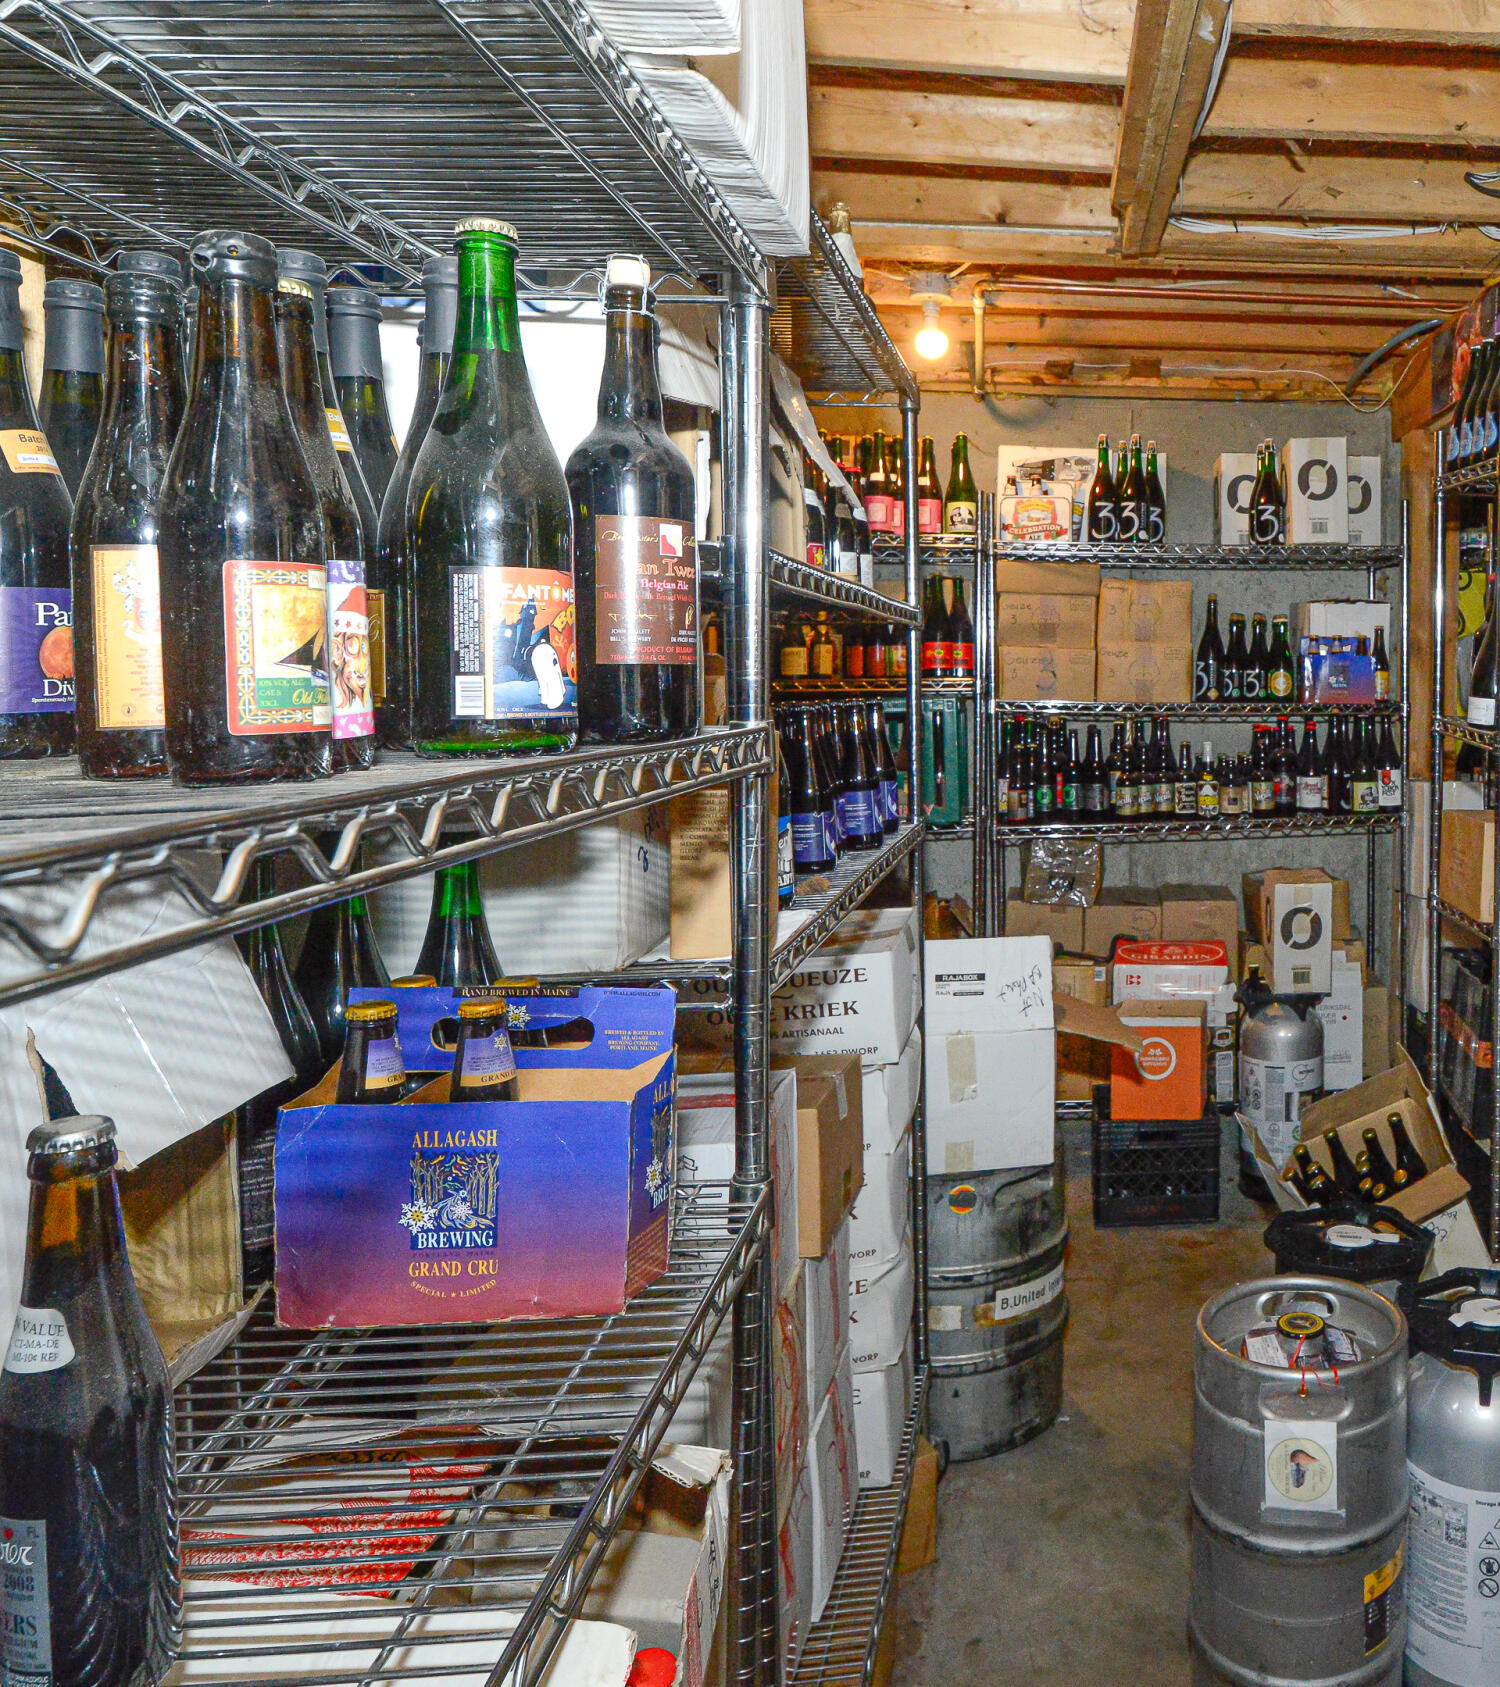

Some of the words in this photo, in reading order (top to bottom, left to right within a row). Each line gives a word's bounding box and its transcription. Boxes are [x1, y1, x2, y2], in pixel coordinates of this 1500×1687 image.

[1008, 523, 1061, 535] CELEBRATION
[1091, 501, 1116, 539] 3
[1119, 501, 1139, 540] 3
[1255, 505, 1279, 542] 3
[501, 580, 574, 603] FANTÔME
[640, 578, 676, 592] Belgian
[786, 967, 868, 988] UEUZE
[490, 988, 527, 997] BREWED
[529, 988, 540, 997] IN
[542, 988, 571, 997] MAINE
[783, 1000, 860, 1021] KRIEK
[781, 1026, 845, 1039] ARTISANAAL
[480, 1072, 510, 1084] GRAND
[412, 1129, 498, 1149] ALLAGASH
[417, 1230, 494, 1249] BREWING
[408, 1260, 462, 1278] GRAND
[467, 1259, 499, 1276] CRU
[410, 1281, 447, 1298] SPECIAL
[460, 1279, 497, 1297] LIMITED
[1000, 1286, 1046, 1311] B.United
[22, 1320, 65, 1337] VALUE
[40, 1353, 59, 1362] REF
